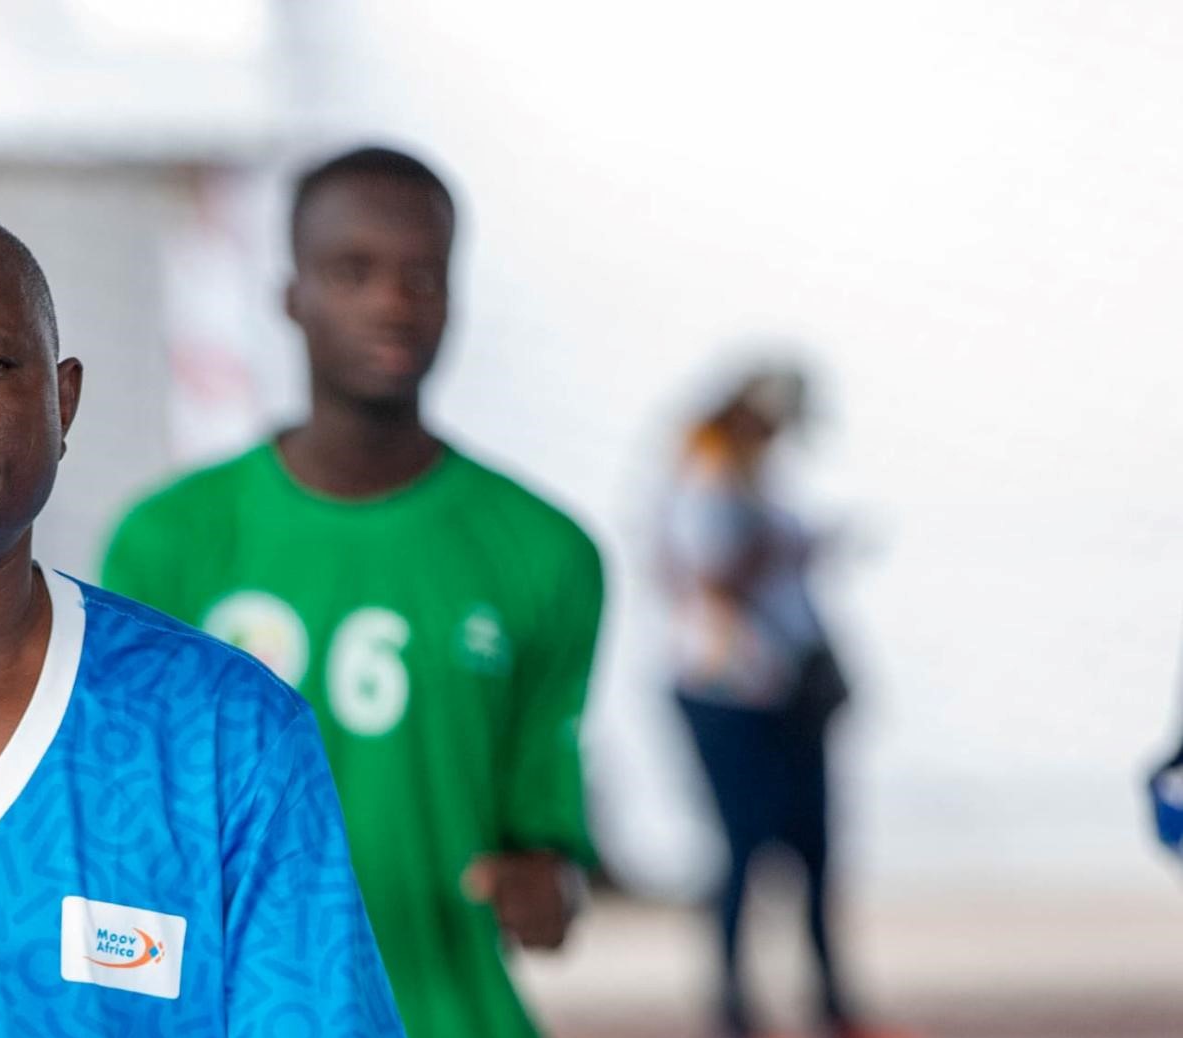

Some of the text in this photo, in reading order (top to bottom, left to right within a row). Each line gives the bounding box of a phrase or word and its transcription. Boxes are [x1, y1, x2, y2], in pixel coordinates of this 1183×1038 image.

[326, 606, 411, 737] 6
[97, 928, 137, 945] Moov
[97, 941, 134, 957] Africa
